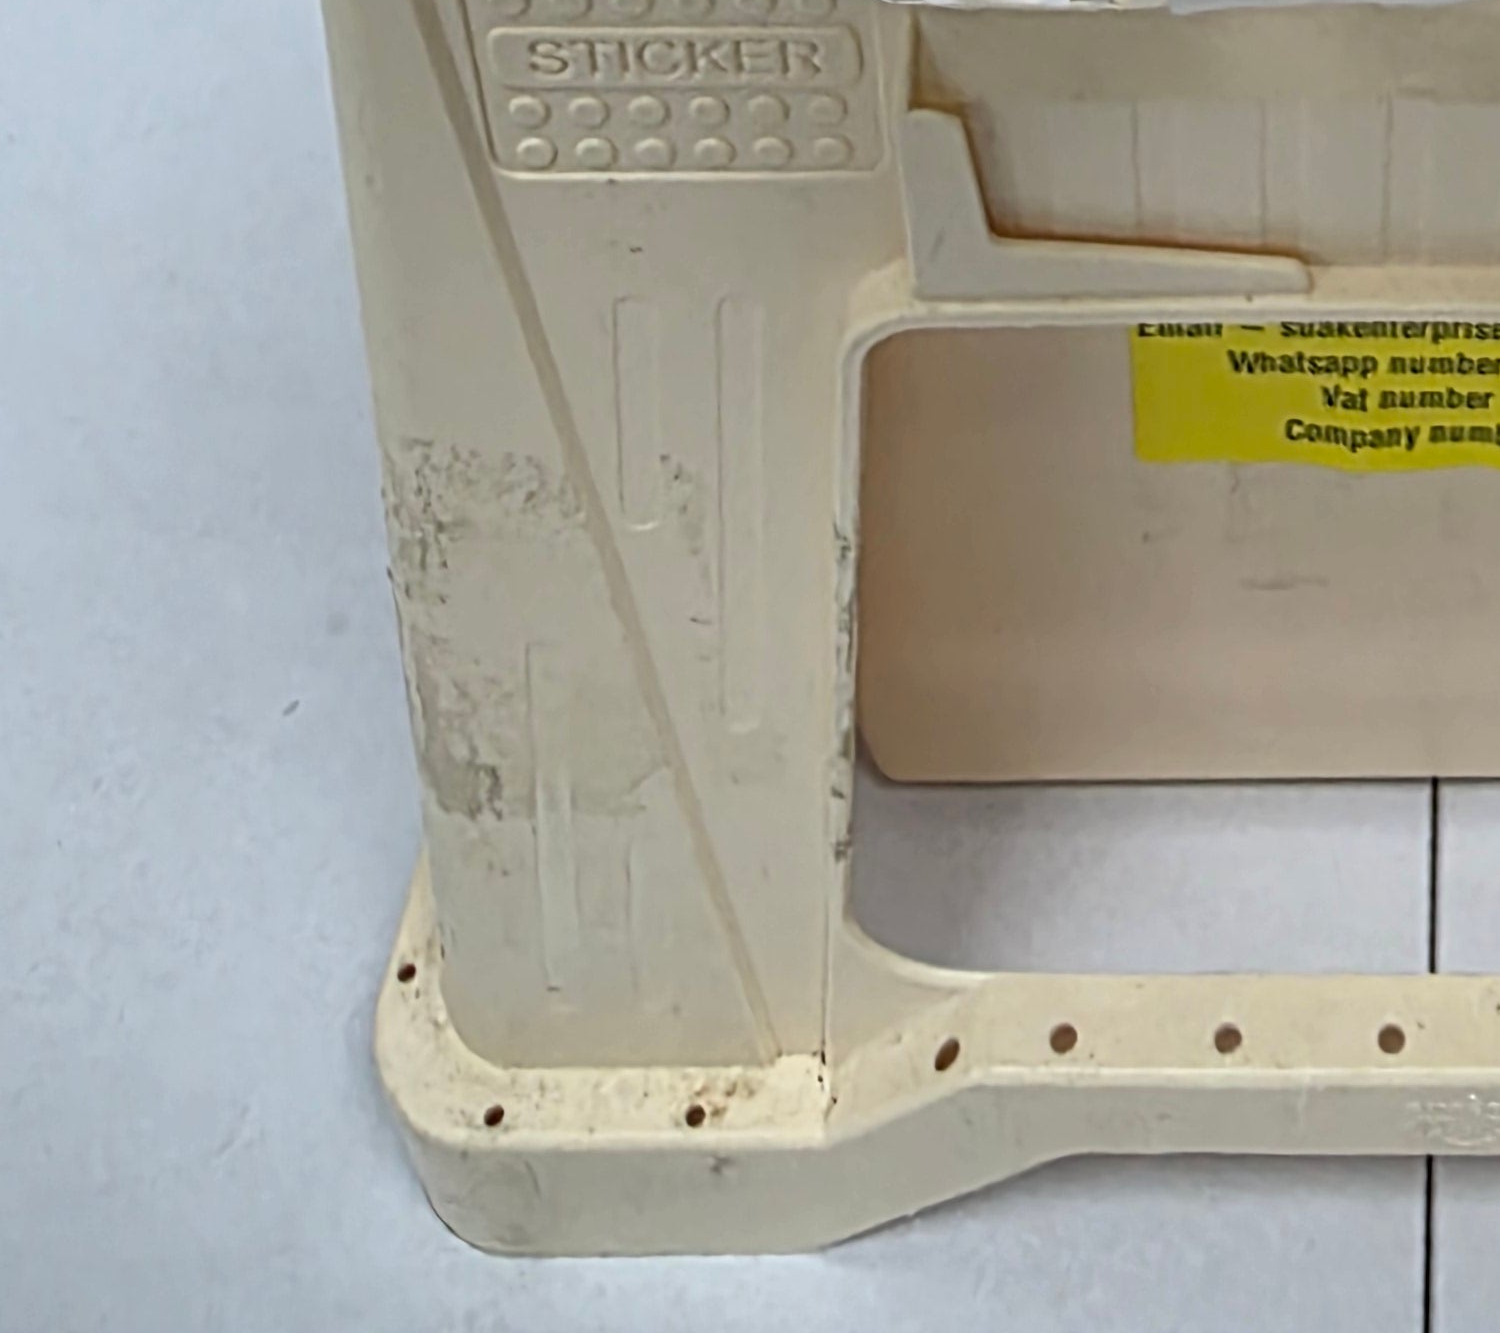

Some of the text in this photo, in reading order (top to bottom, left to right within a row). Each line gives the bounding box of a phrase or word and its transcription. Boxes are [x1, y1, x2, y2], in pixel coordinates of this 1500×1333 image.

[526, 37, 824, 80] STICKER
[1226, 349, 1379, 380] Whatsapp
[1321, 384, 1369, 412] Vat
[1379, 387, 1496, 410] number
[1284, 418, 1420, 453] Company
